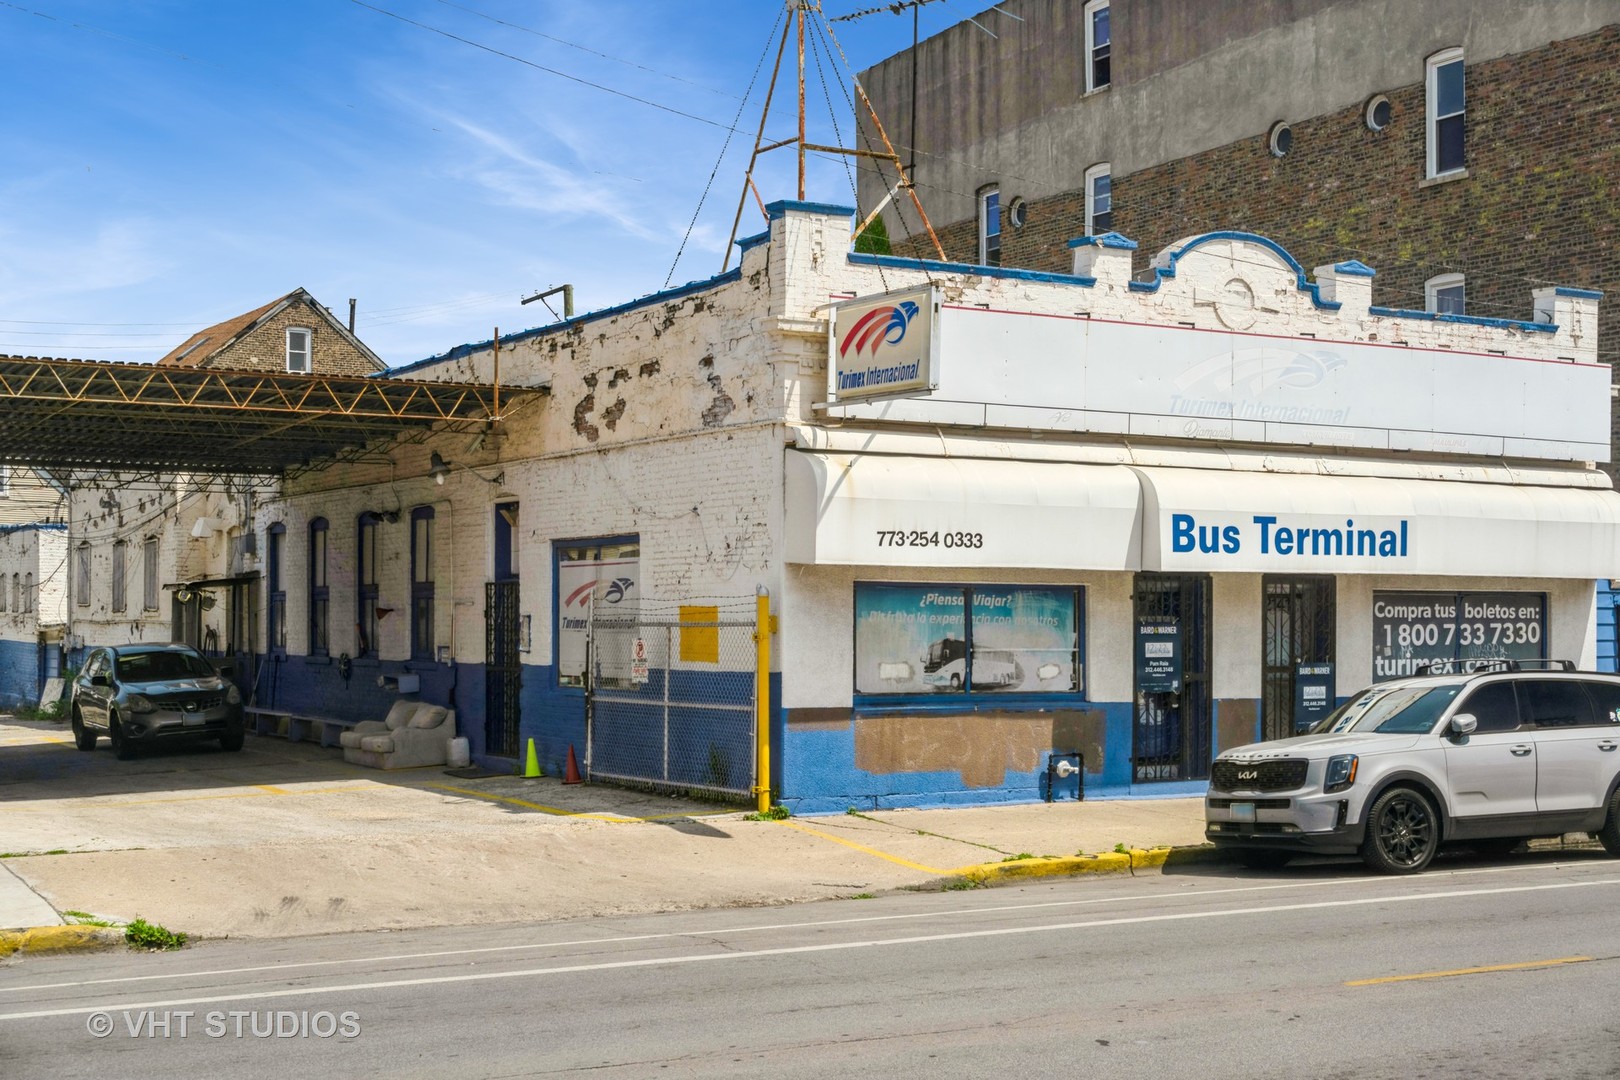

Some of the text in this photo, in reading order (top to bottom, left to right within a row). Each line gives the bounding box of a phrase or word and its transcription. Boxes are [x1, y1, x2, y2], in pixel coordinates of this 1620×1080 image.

[838, 359, 920, 390] Turimex Internacional
[1169, 394, 1351, 423] Turimex Internacional
[943, 531, 983, 549] 0333
[1172, 514, 1408, 557] Bus Terminal
[973, 593, 1012, 609] Viajar?
[917, 611, 927, 624] la
[994, 615, 1012, 625] con
[1374, 601, 1540, 622] Compra tus boletos en:
[562, 616, 588, 629] Turimex
[1383, 624, 1392, 646] 1
[1398, 623, 1439, 646] 800
[1490, 621, 1540, 645] 7330
[1238, 771, 1257, 780] KIA
